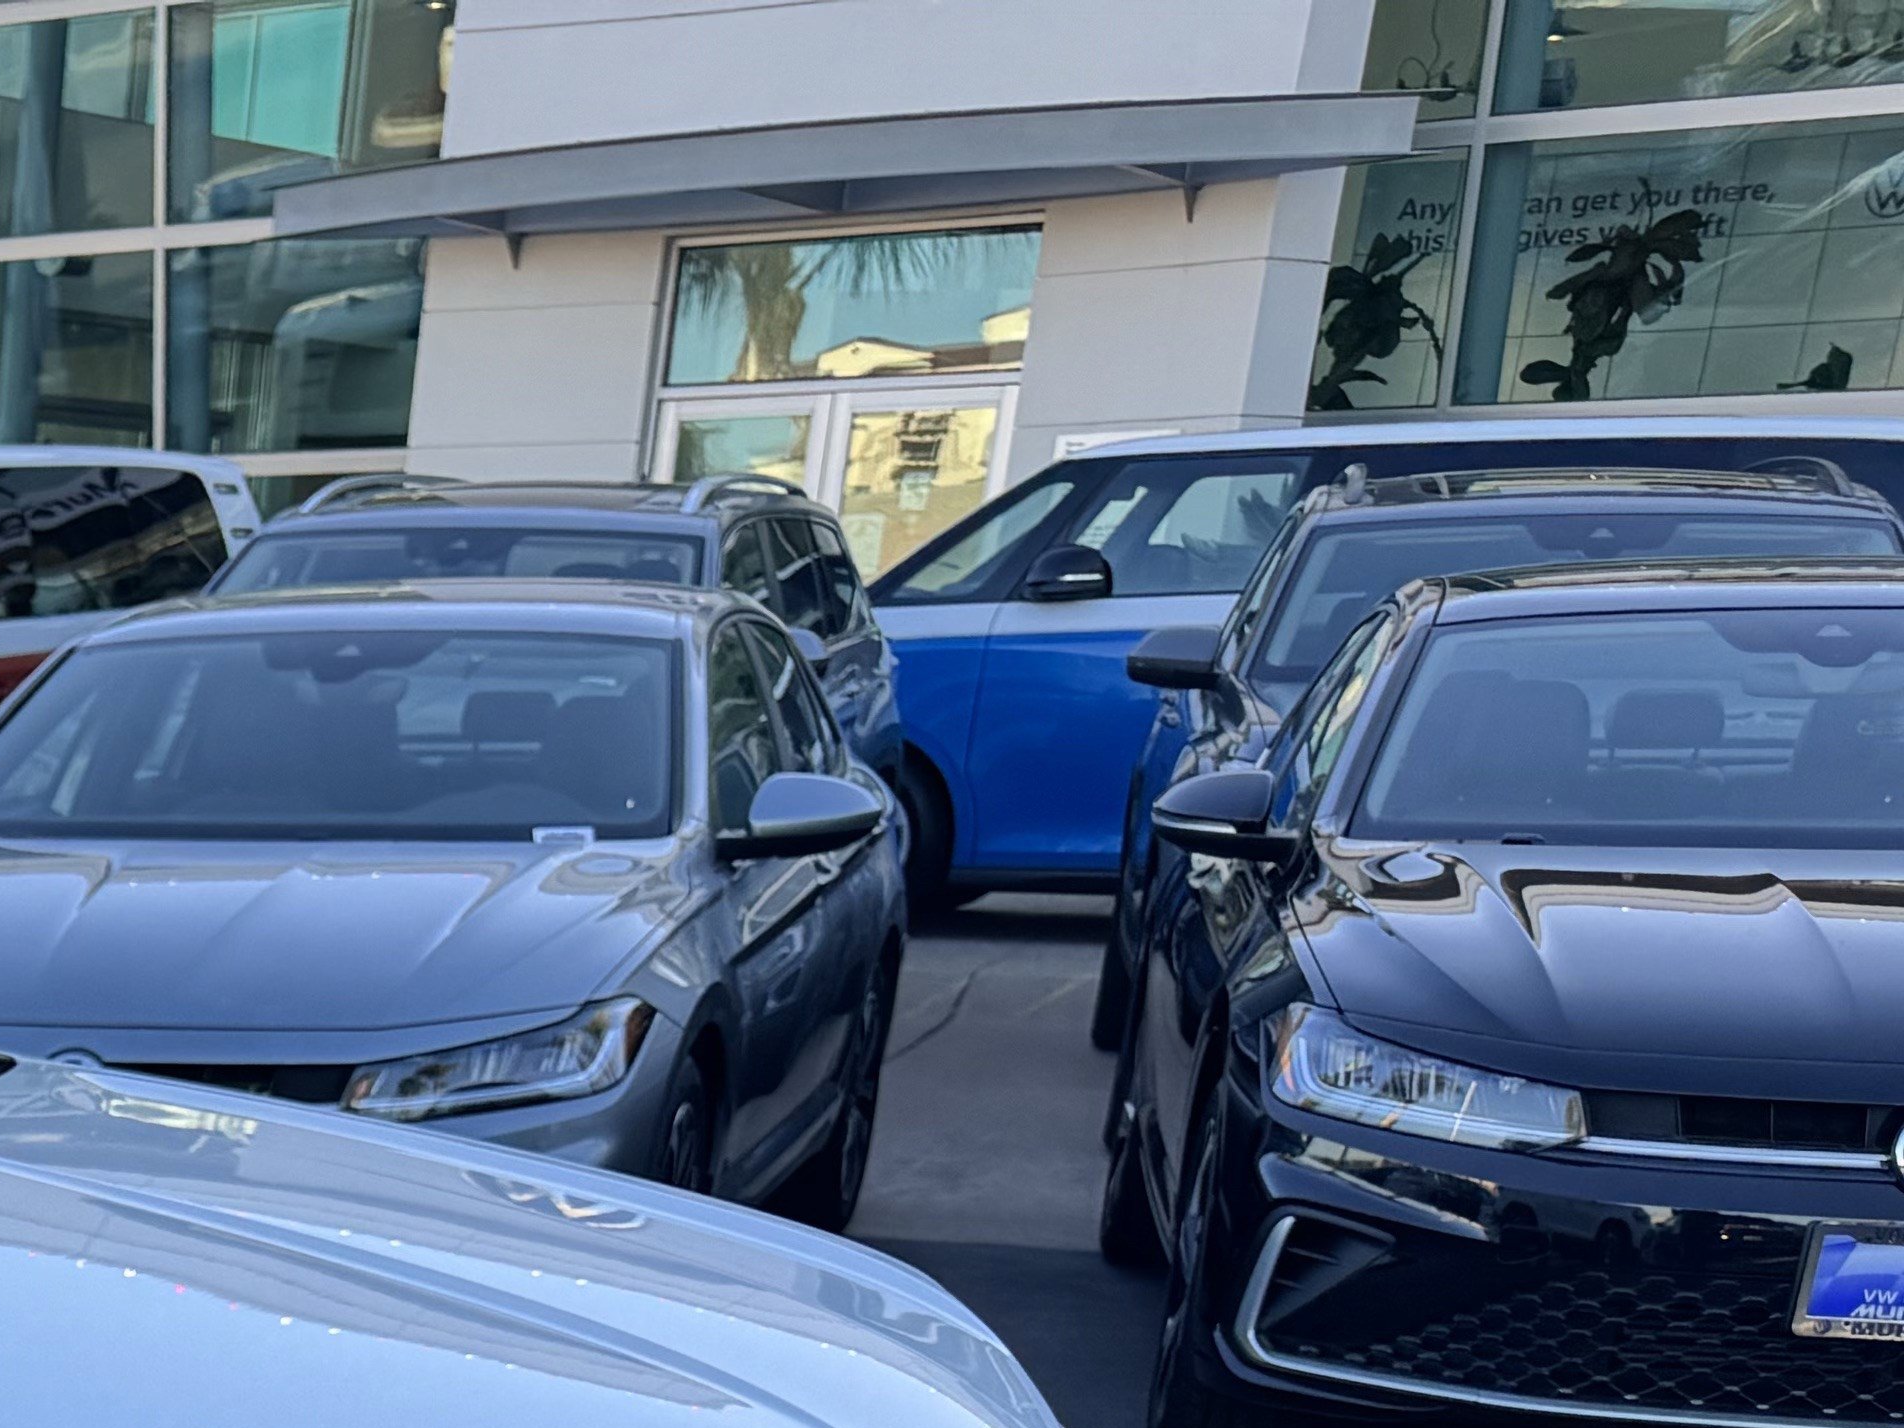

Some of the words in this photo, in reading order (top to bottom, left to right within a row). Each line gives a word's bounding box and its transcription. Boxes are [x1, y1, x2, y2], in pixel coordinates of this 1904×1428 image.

[1397, 198, 1454, 225] Any
[1526, 196, 1562, 215] an
[1572, 189, 1621, 218] get
[1691, 180, 1775, 205] there,
[1406, 228, 1445, 252] his
[1518, 223, 1590, 252] gives
[1864, 1288, 1899, 1305] VW
